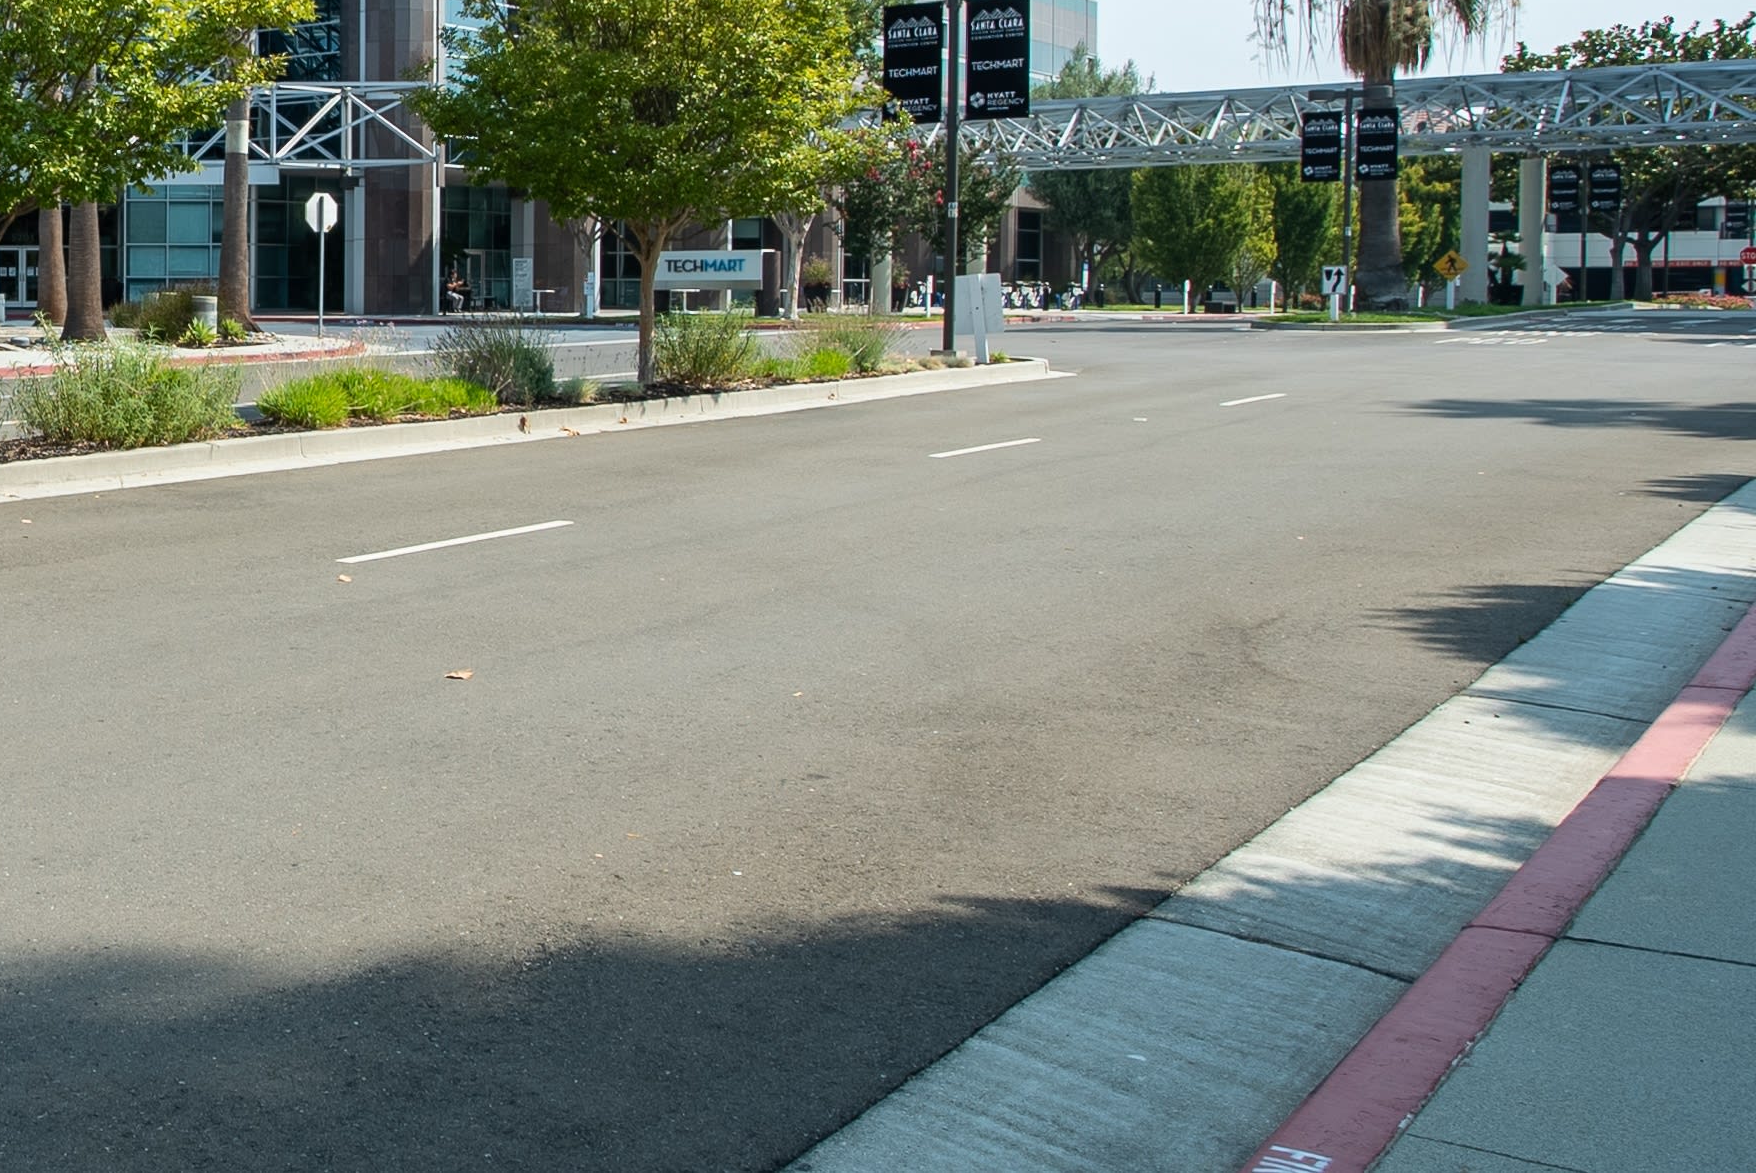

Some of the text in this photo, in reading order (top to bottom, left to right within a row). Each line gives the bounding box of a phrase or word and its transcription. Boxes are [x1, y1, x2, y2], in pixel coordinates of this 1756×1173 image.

[971, 18, 996, 31] SANTA
[998, 17, 1024, 28] CLARA
[887, 27, 911, 40] SANTA
[914, 26, 938, 37] CLARA
[971, 58, 1025, 71] TECHMART
[888, 65, 939, 78] TECHMART
[902, 97, 930, 105] HYATT
[987, 97, 1025, 106] REGENCY
[1740, 252, 1756, 261] STO
[664, 258, 746, 273] TECHMART
